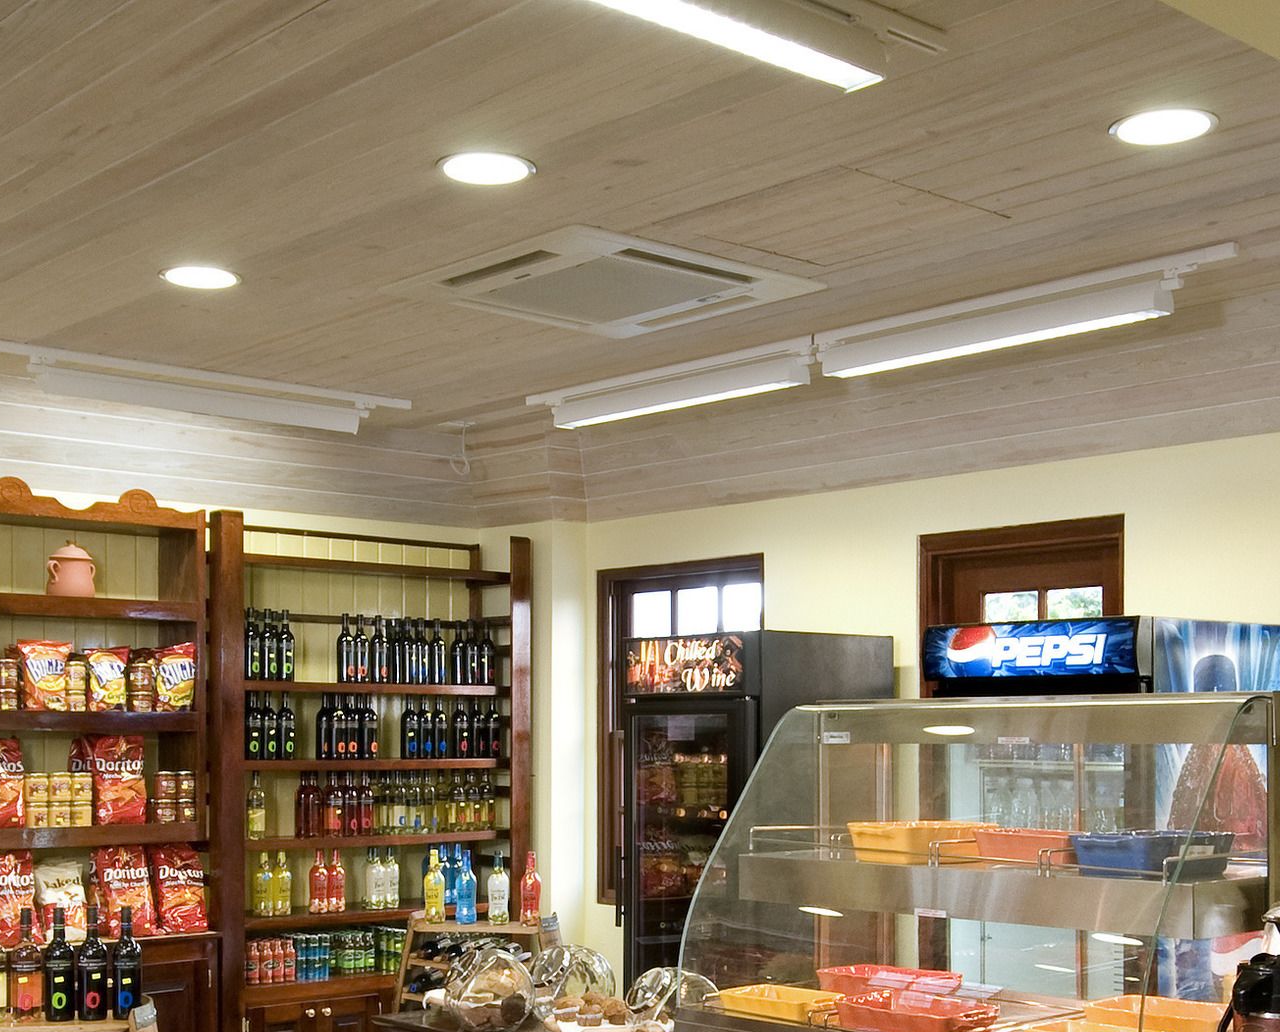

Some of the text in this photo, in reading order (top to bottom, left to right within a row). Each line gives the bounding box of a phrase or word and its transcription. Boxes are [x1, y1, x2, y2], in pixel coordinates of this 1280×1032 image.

[664, 639, 718, 665] Chilled
[991, 633, 1105, 668] PEPSI
[682, 665, 736, 692] Wine
